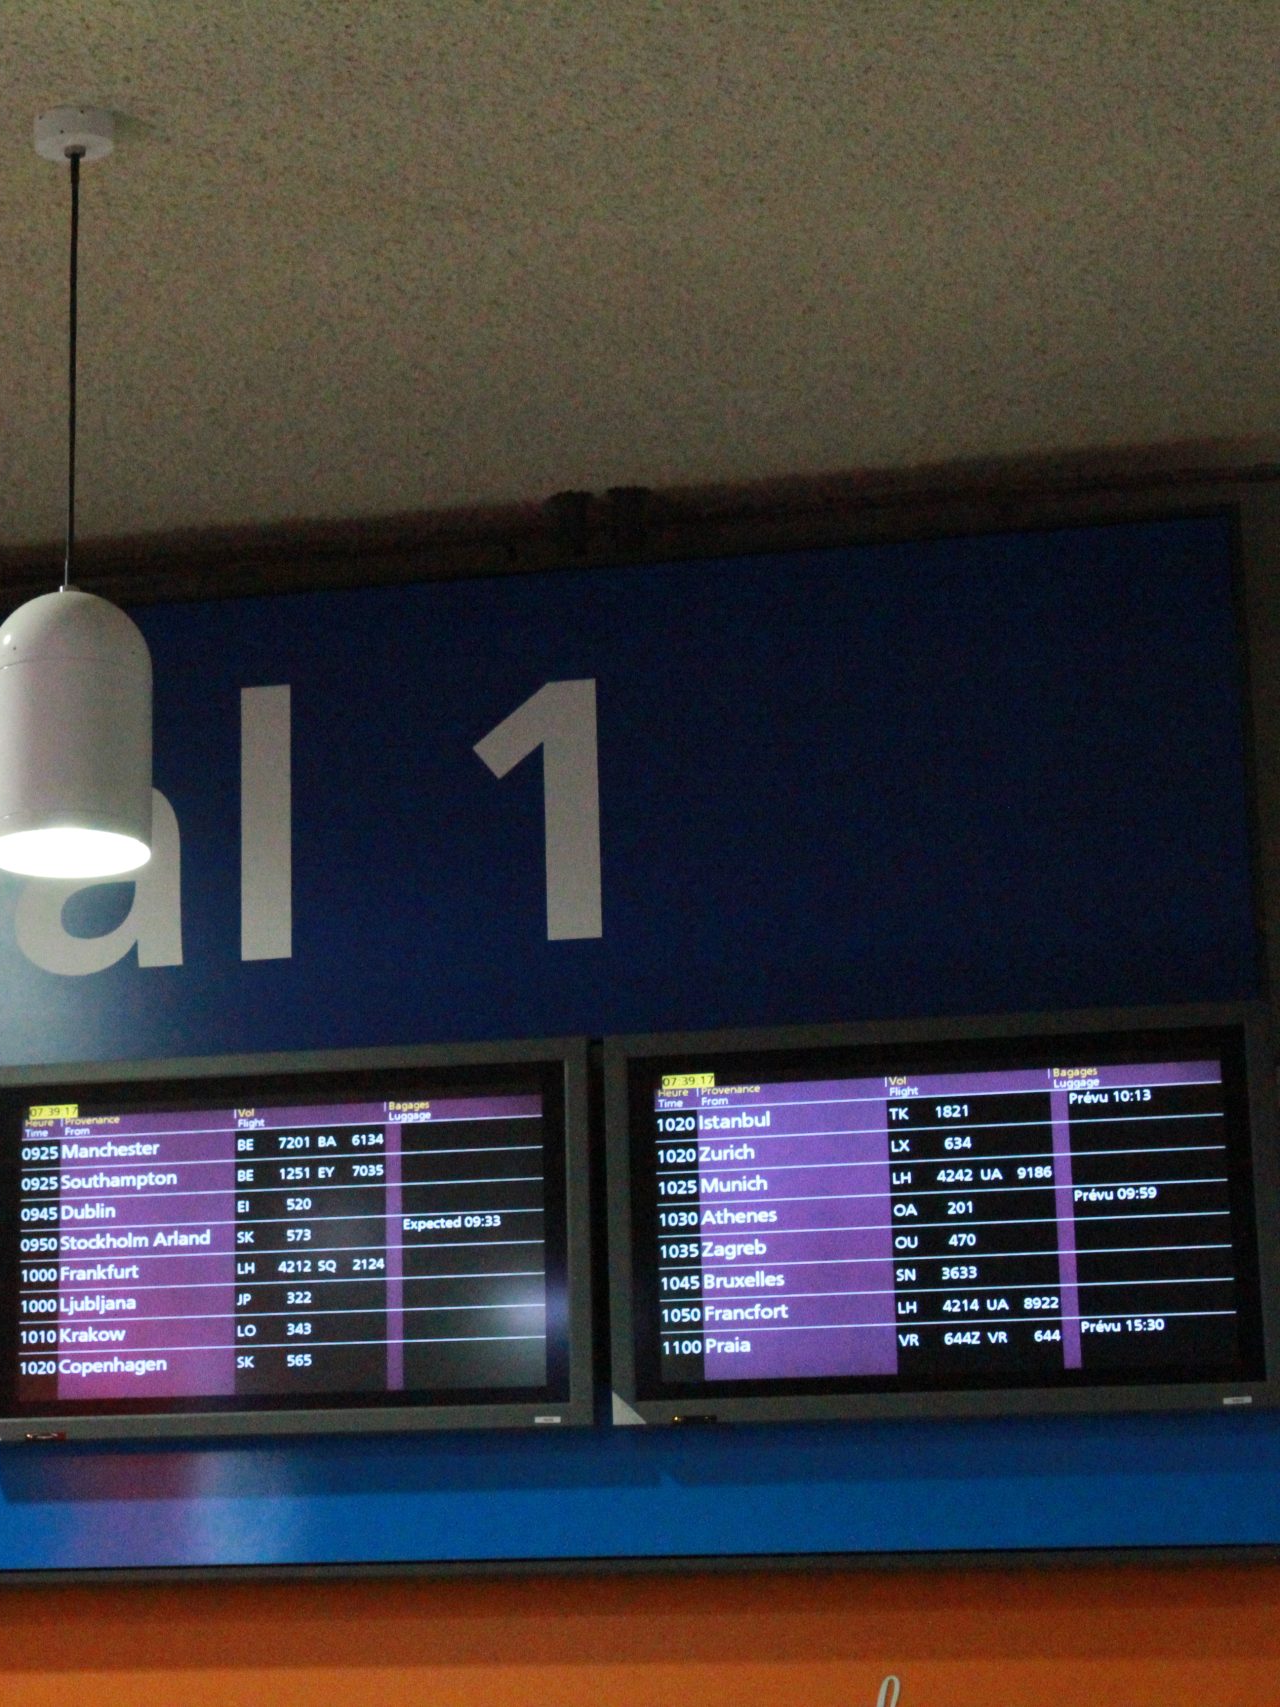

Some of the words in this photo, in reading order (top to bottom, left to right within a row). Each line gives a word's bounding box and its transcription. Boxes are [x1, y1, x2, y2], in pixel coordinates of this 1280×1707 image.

[472, 678, 602, 941] 1
[889, 1076, 907, 1086] Vol
[1053, 1067, 1098, 1079] Bagages
[1053, 1078, 1100, 1090] Luggage
[889, 1086, 919, 1098] Flight
[1069, 1091, 1108, 1104] Prévu
[1114, 1089, 1151, 1102] 10:13
[25, 1128, 48, 1138] Time
[64, 1127, 90, 1136] From
[238, 1119, 265, 1129] Flight
[657, 1117, 695, 1132] 1020
[699, 1111, 770, 1130] Istanbul
[889, 1108, 908, 1120] TK
[936, 1105, 968, 1118] 1821
[22, 1146, 58, 1160] 0925
[62, 1142, 160, 1159] Manchester
[238, 1139, 254, 1151] BE
[279, 1136, 309, 1149] 7201
[658, 1148, 696, 1163] 1020
[699, 1144, 755, 1162] Zurich
[891, 1140, 910, 1152] LX
[944, 1136, 971, 1150] 634
[22, 1176, 58, 1190] 0925
[61, 1172, 177, 1190] Southampton
[238, 1169, 254, 1182] BE
[280, 1167, 309, 1180] 1251
[659, 1180, 697, 1194] 1025
[701, 1175, 768, 1193] Munich
[893, 1172, 911, 1184] LH
[937, 1169, 972, 1182] 4242
[1074, 1188, 1113, 1201] Prévu
[1117, 1187, 1156, 1200] 09:59
[21, 1207, 58, 1221] 0945
[61, 1203, 116, 1220] Dublin
[238, 1200, 249, 1212] EI
[287, 1198, 311, 1210] 520
[660, 1212, 698, 1226] 1030
[701, 1208, 777, 1225] Athenes
[894, 1204, 917, 1216] OA
[948, 1201, 972, 1214] 201
[403, 1216, 461, 1232] Expected
[464, 1215, 501, 1227] 09:33
[20, 1238, 57, 1252] 0950
[60, 1232, 148, 1250] Stockholm
[153, 1229, 210, 1246] Arland
[237, 1231, 254, 1243] SK
[287, 1229, 311, 1241] 573
[661, 1244, 699, 1258] 1035
[702, 1239, 766, 1260] Zagreb
[895, 1236, 918, 1249] OU
[949, 1234, 976, 1246] 470
[22, 1268, 57, 1282] 1000
[60, 1264, 139, 1281] Frankfurt
[238, 1262, 255, 1274] LH
[278, 1260, 311, 1272] 4212
[662, 1276, 700, 1290] 1045
[704, 1270, 784, 1289] Bruxelles
[896, 1269, 916, 1281] SN
[942, 1266, 977, 1280] 3633
[22, 1299, 57, 1313] 1000
[60, 1295, 136, 1315] Ljubljana
[237, 1294, 251, 1306] JP
[287, 1291, 311, 1304] 322
[662, 1308, 701, 1322] 1050
[705, 1304, 788, 1321] Francfort
[898, 1302, 916, 1314] LH
[943, 1299, 979, 1312] 4214
[21, 1330, 56, 1344] 1010
[60, 1326, 126, 1342] Krakow
[238, 1324, 256, 1337] LO
[287, 1323, 311, 1335] 343
[1081, 1320, 1121, 1332] Prévu
[1126, 1318, 1164, 1331] 15:30
[664, 1340, 702, 1354] 1100
[706, 1336, 750, 1353] Praia
[898, 1334, 919, 1346] VR
[944, 1332, 980, 1345] 644Z
[20, 1361, 56, 1374] 1020
[59, 1356, 167, 1377] Copenhagen
[237, 1356, 254, 1368] SK
[287, 1354, 312, 1366] 565
